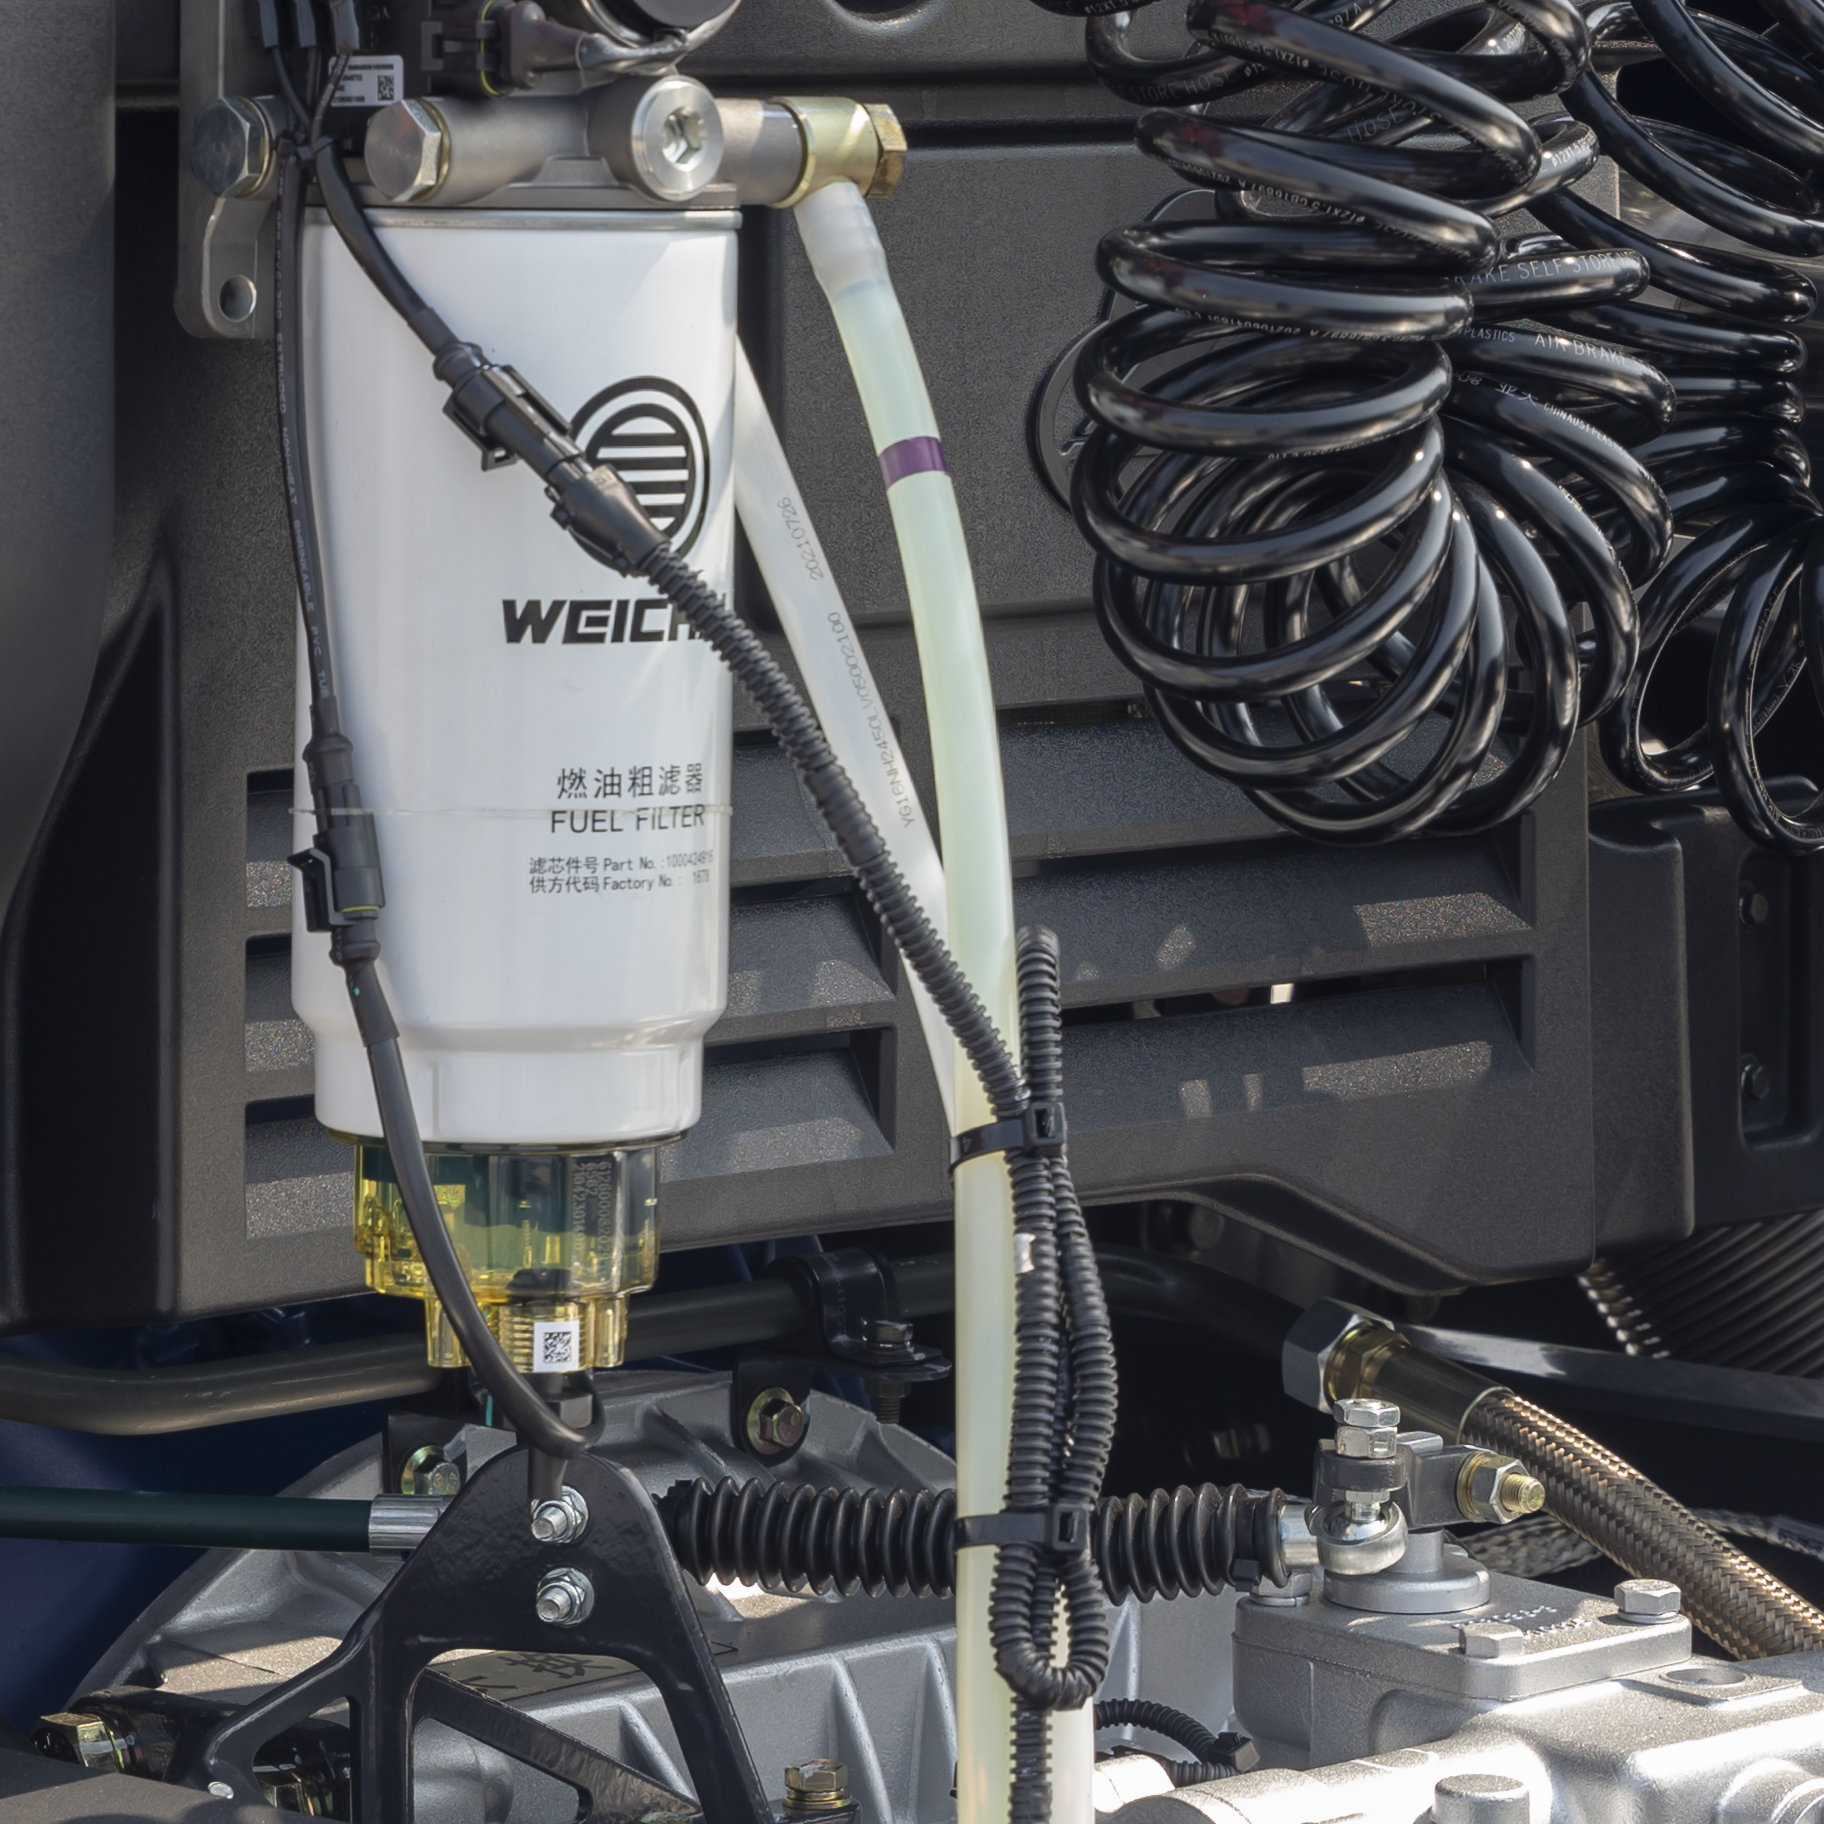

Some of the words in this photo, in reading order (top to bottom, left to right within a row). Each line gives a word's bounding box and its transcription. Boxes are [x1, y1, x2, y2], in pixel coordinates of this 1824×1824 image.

[1183, 68, 1236, 95] HOSE
[1517, 257, 1562, 280] SELF
[776, 496, 824, 581] 20210726
[282, 426, 298, 506] NON-HEAT
[310, 625, 322, 656] PVC
[317, 670, 330, 699] TUB
[502, 597, 699, 645] WEICH
[557, 763, 703, 800] 燃油粗滤器
[551, 809, 623, 834] FUEL
[636, 804, 706, 831] FILTER
[529, 856, 599, 875] 滤芯件号
[603, 857, 634, 872] Part
[529, 875, 600, 894] 供方代码
[603, 876, 655, 892] Factory
